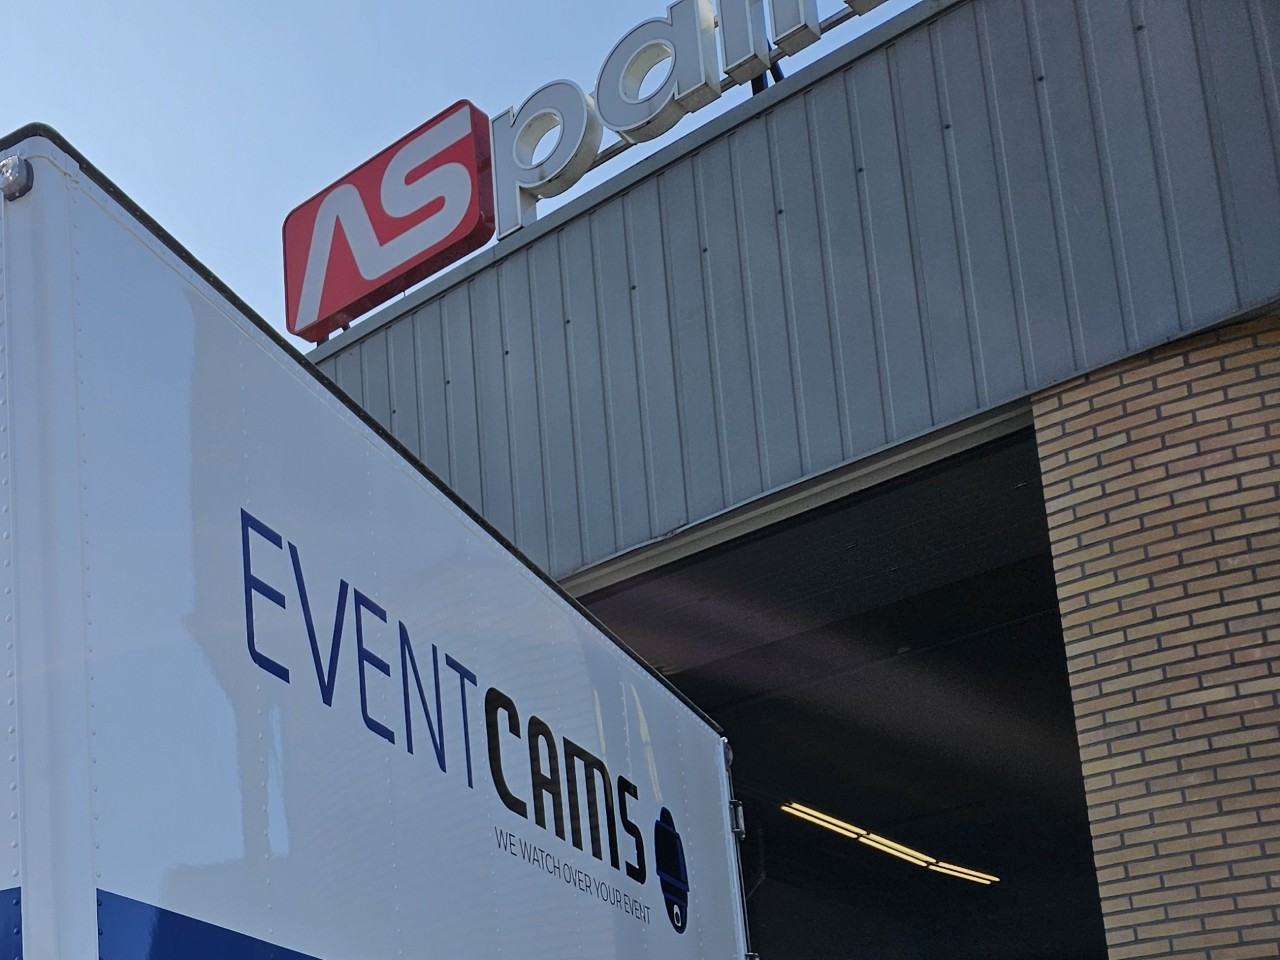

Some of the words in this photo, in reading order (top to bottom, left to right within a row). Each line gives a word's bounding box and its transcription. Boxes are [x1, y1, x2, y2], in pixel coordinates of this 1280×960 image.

[294, 105, 472, 330] AS
[494, 826, 518, 857] WE
[519, 838, 562, 879] WATCH
[563, 863, 593, 896] OVER
[592, 877, 623, 910] YOUR
[623, 893, 651, 925] EVENT
